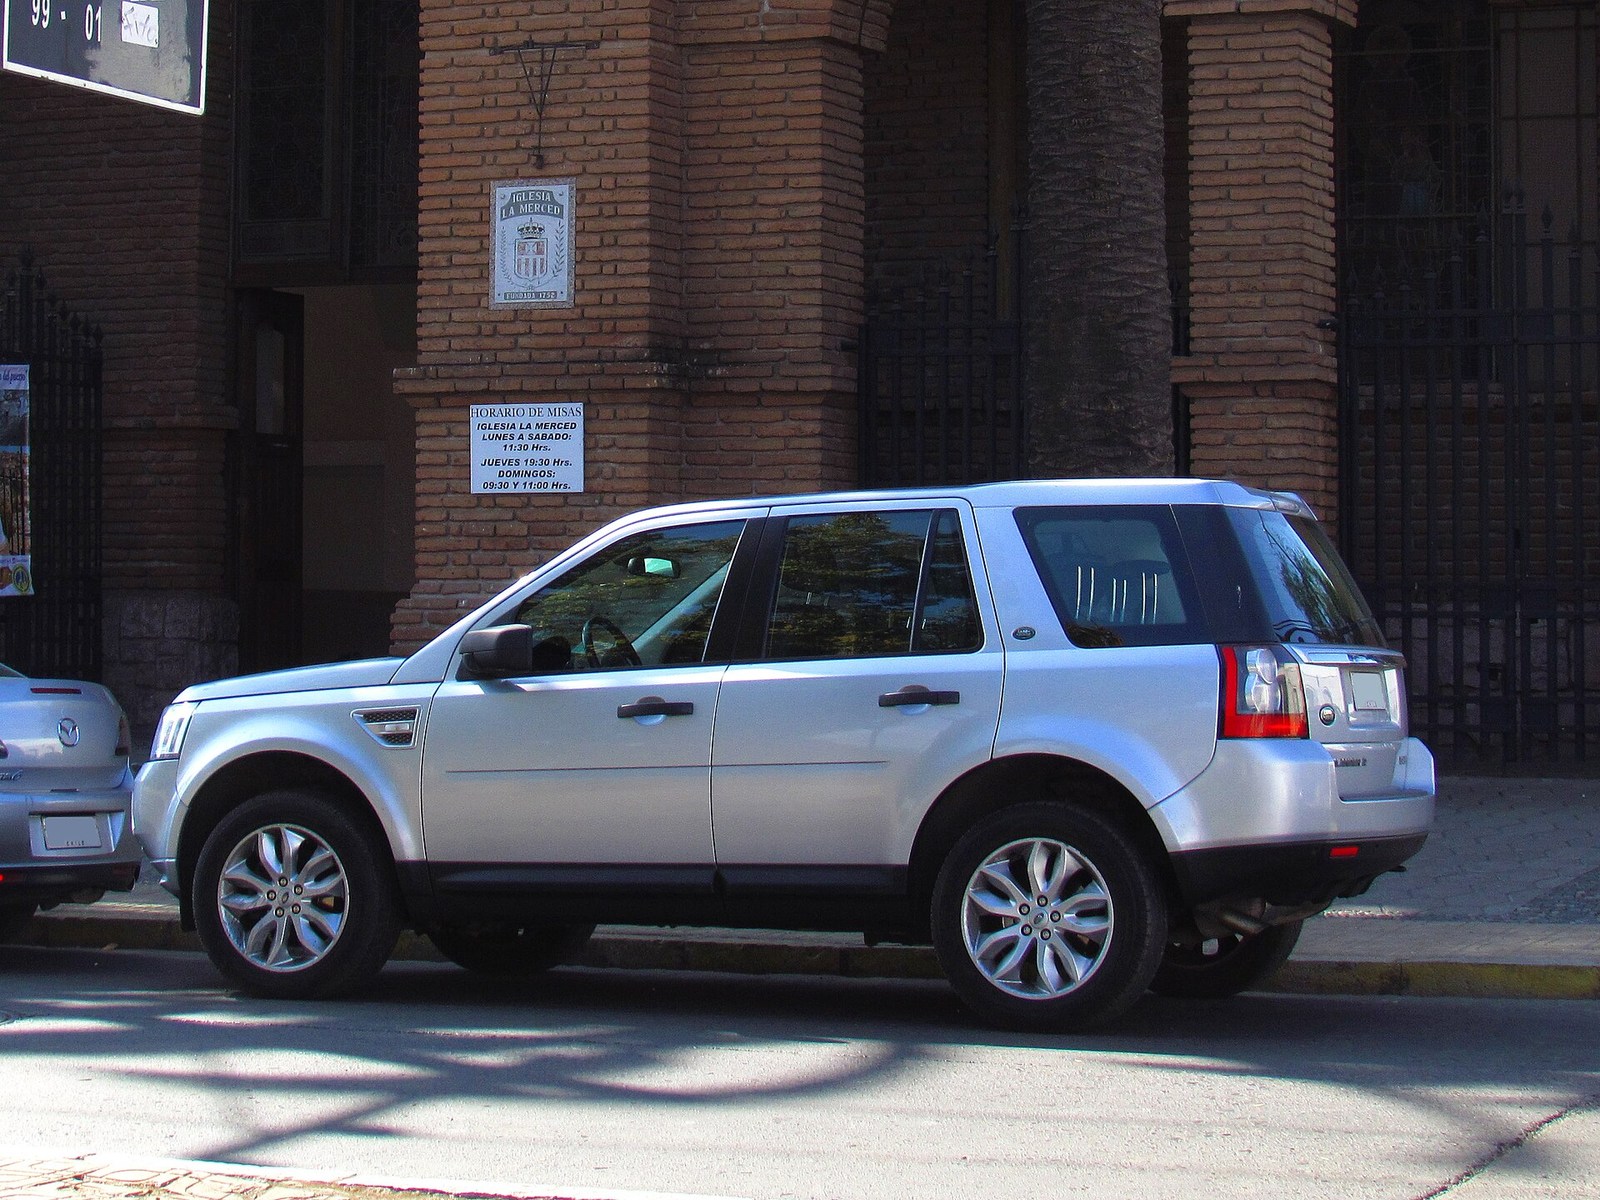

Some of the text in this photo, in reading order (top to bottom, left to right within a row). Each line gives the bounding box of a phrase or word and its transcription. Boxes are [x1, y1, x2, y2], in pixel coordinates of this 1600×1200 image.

[85, 4, 102, 42] 01
[512, 191, 551, 203] IGLESIA
[502, 203, 560, 218] LA MERCED
[471, 406, 582, 418] HORARIO DE MISAS
[477, 422, 577, 430] IGLESIA LA MERCED
[482, 433, 515, 441] LUNES
[480, 459, 520, 467] JUEVES
[498, 470, 556, 478] DOMINGOS:
